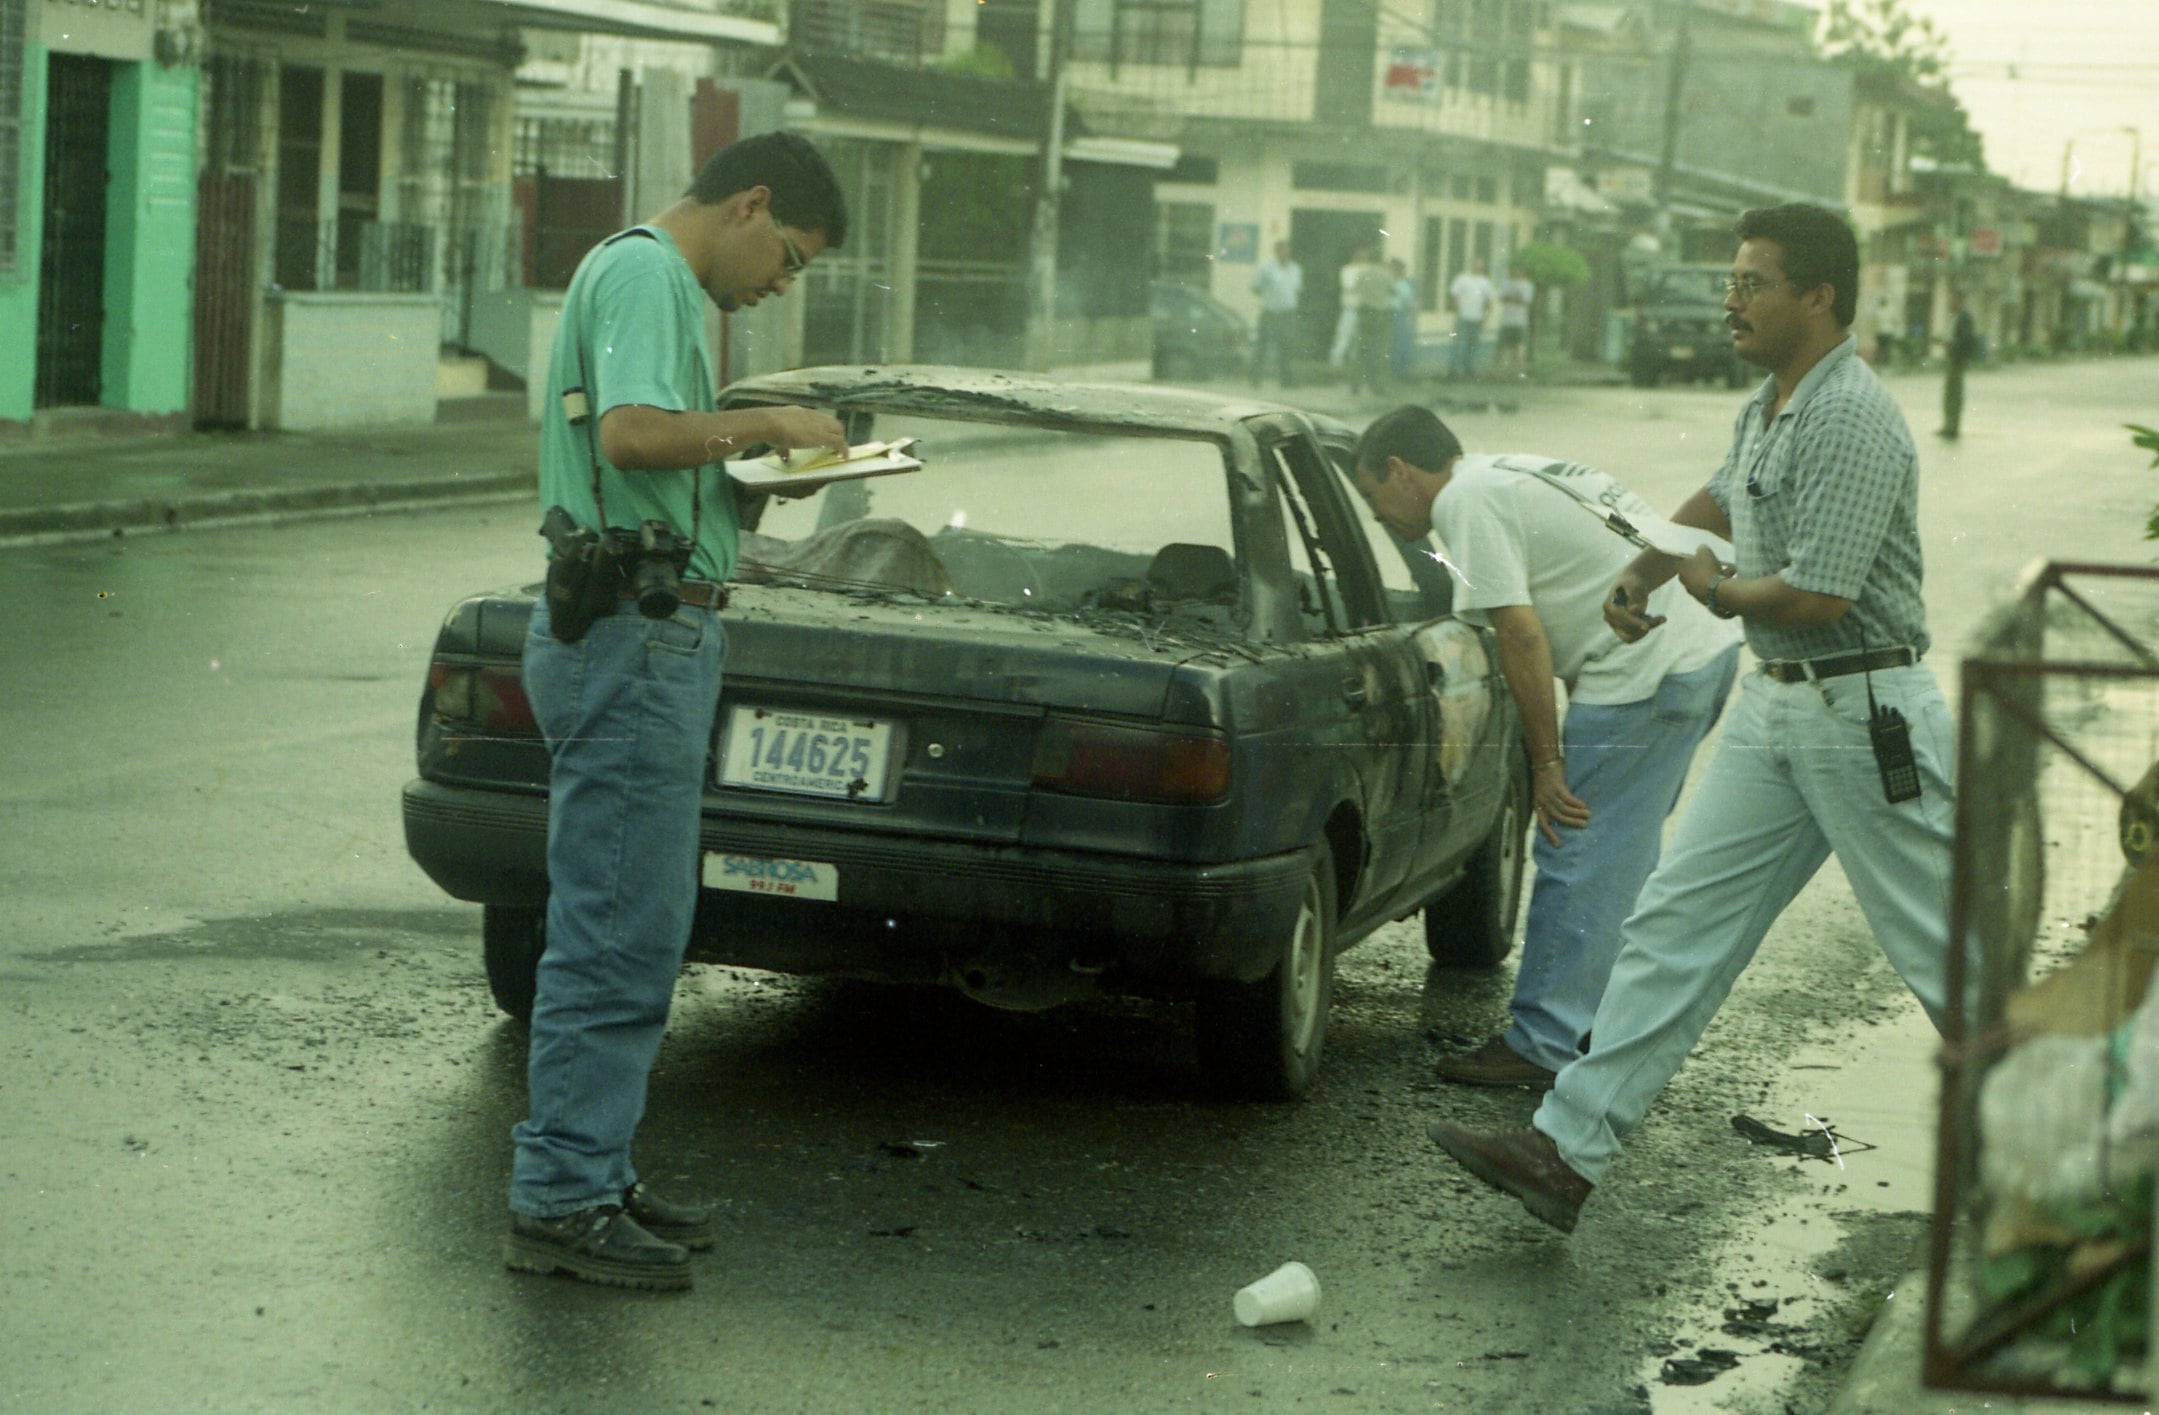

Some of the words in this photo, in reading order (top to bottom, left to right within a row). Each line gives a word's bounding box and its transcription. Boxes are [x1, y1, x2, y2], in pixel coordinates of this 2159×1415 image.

[775, 715, 814, 730] COSTA
[820, 719, 848, 733] RICA
[751, 727, 871, 778] 144625
[753, 771, 857, 792] CENTROAMERIC
[723, 856, 819, 884] SABROSA
[776, 881, 796, 894] FM
